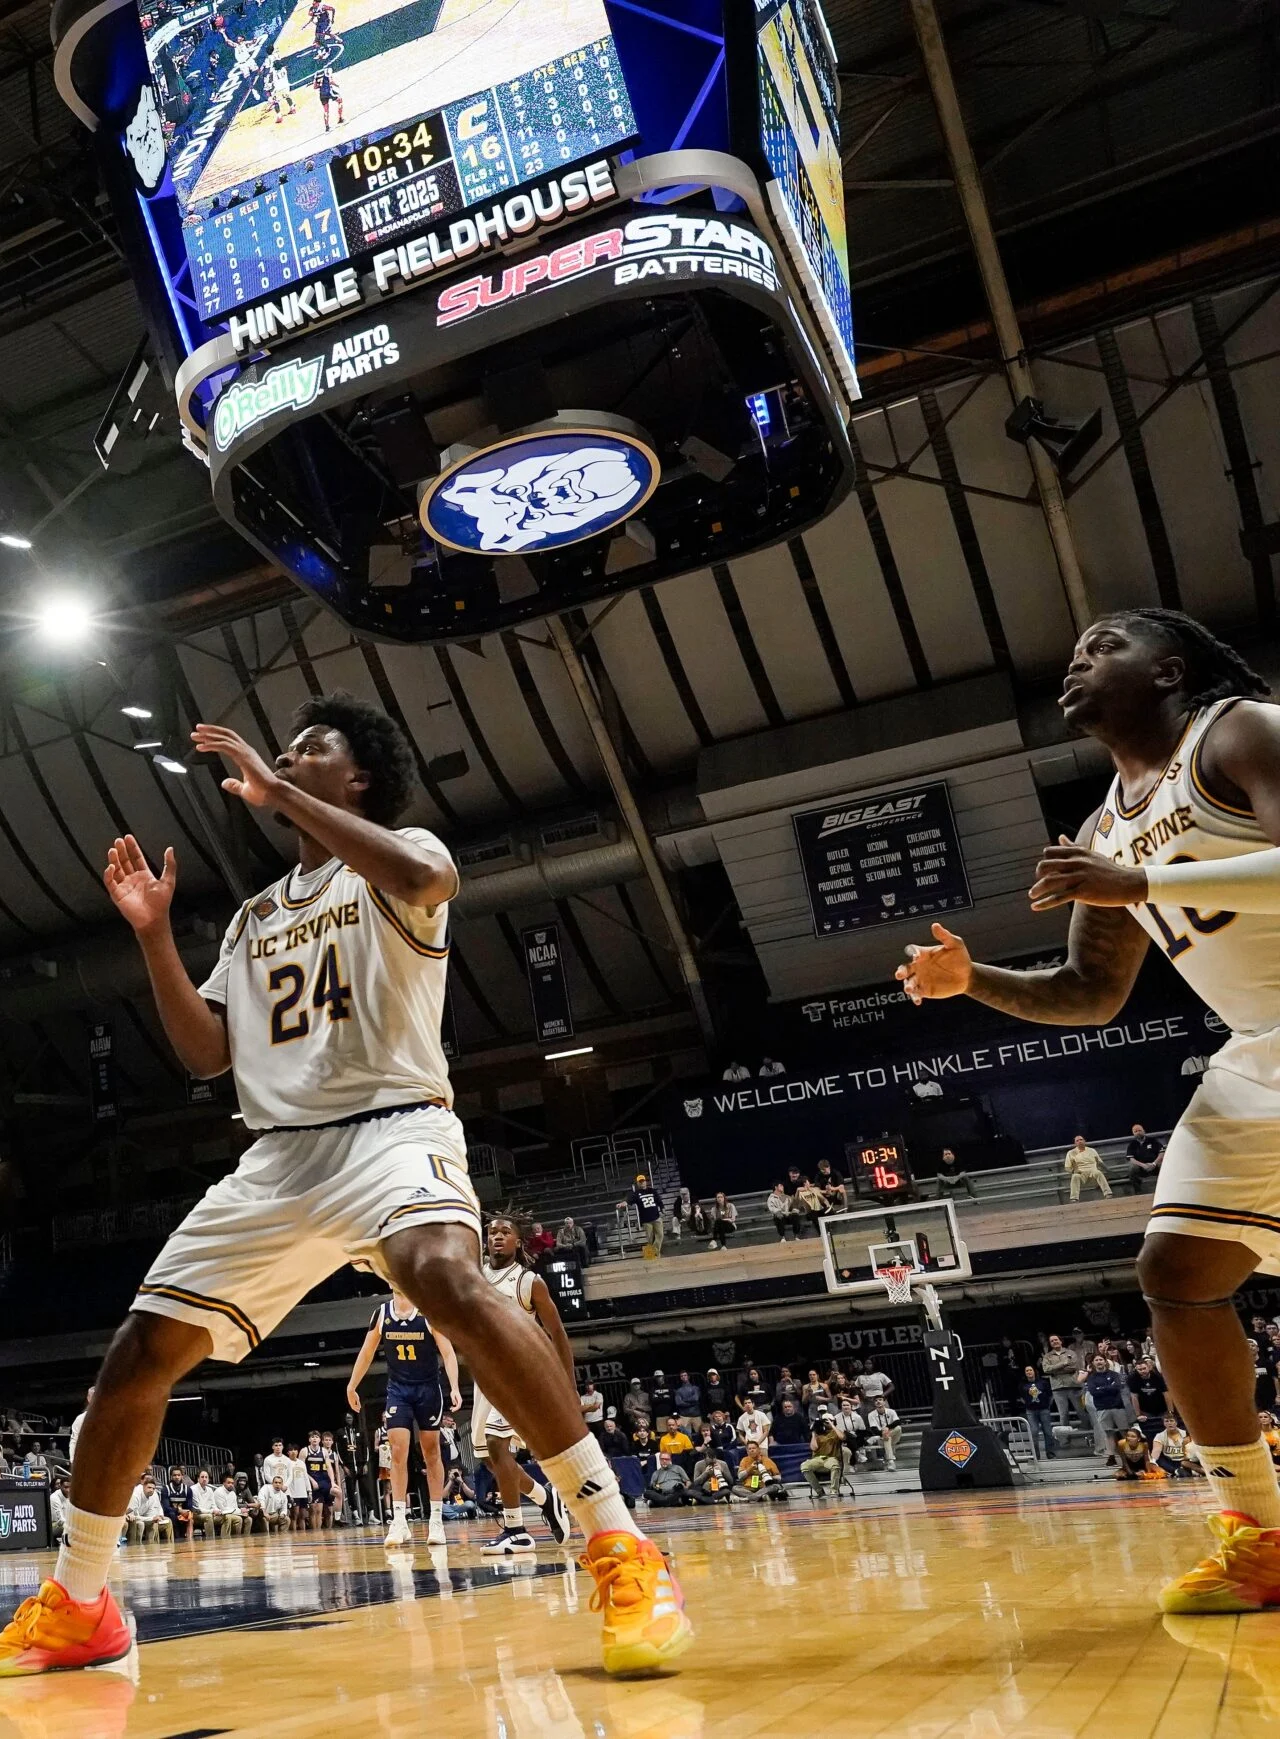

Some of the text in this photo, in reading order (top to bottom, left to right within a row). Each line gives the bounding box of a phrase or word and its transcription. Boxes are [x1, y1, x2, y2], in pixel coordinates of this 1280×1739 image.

[346, 122, 432, 179] 10:34
[462, 135, 502, 168] 16
[367, 159, 414, 191] PER 1
[464, 167, 493, 186] FLS:
[215, 213, 233, 228] PTS
[240, 201, 259, 216] REB
[265, 192, 278, 204] PF
[358, 174, 440, 232] NIT 2025
[198, 206, 278, 250] 1 0 1 0
[298, 208, 332, 241] 17
[377, 207, 431, 236] INDIANAPOLIS
[197, 221, 281, 267] 10 0 1 0
[300, 240, 326, 258] FLS:
[200, 236, 284, 282] 14 0 1 0
[229, 160, 617, 352] HINKLE FIELDHOUSE
[203, 252, 288, 298] 24 2 1 0
[614, 255, 776, 292] BATTERIES
[205, 268, 291, 313] 77 2 0 0
[331, 324, 390, 365] AUTO
[326, 342, 400, 388] PARTS
[215, 357, 323, 451] O'Reilly
[866, 812, 923, 830] CONFERENCE
[866, 839, 889, 852] UCONN
[906, 828, 942, 844] CREIGHTON
[1129, 805, 1199, 866] IRVINE
[826, 848, 850, 862] BUTLER
[859, 852, 902, 869] GEORGETOWN
[909, 842, 947, 858] MARQUETTE
[829, 862, 852, 875] DEPAUL
[865, 867, 902, 882] SETON HALL
[923, 857, 946, 870] JOHN'S
[818, 876, 856, 892] PROVIDENCE
[915, 873, 939, 887] XAVIER
[824, 890, 859, 905] VILLANOVA
[250, 935, 278, 959] UC
[528, 943, 558, 963] NCAA
[269, 943, 352, 1045] 24
[828, 990, 914, 1015] Francisca
[832, 1010, 885, 1029] HEALTH
[713, 1015, 1188, 1113] WELCOME TO HINKLE FIELDHOUSE
[861, 1147, 898, 1165] 10:34
[874, 1166, 899, 1189] 16
[641, 1196, 658, 1209] 22
[561, 1274, 574, 1288] 16
[572, 1298, 580, 1309] 4
[829, 1324, 922, 1351] BUTLER
[396, 1344, 417, 1361] 11
[929, 1346, 954, 1391] NIT
[945, 1445, 968, 1453] NIT
[14, 1504, 35, 1519] AUTO
[12, 1518, 38, 1533] PARTS
